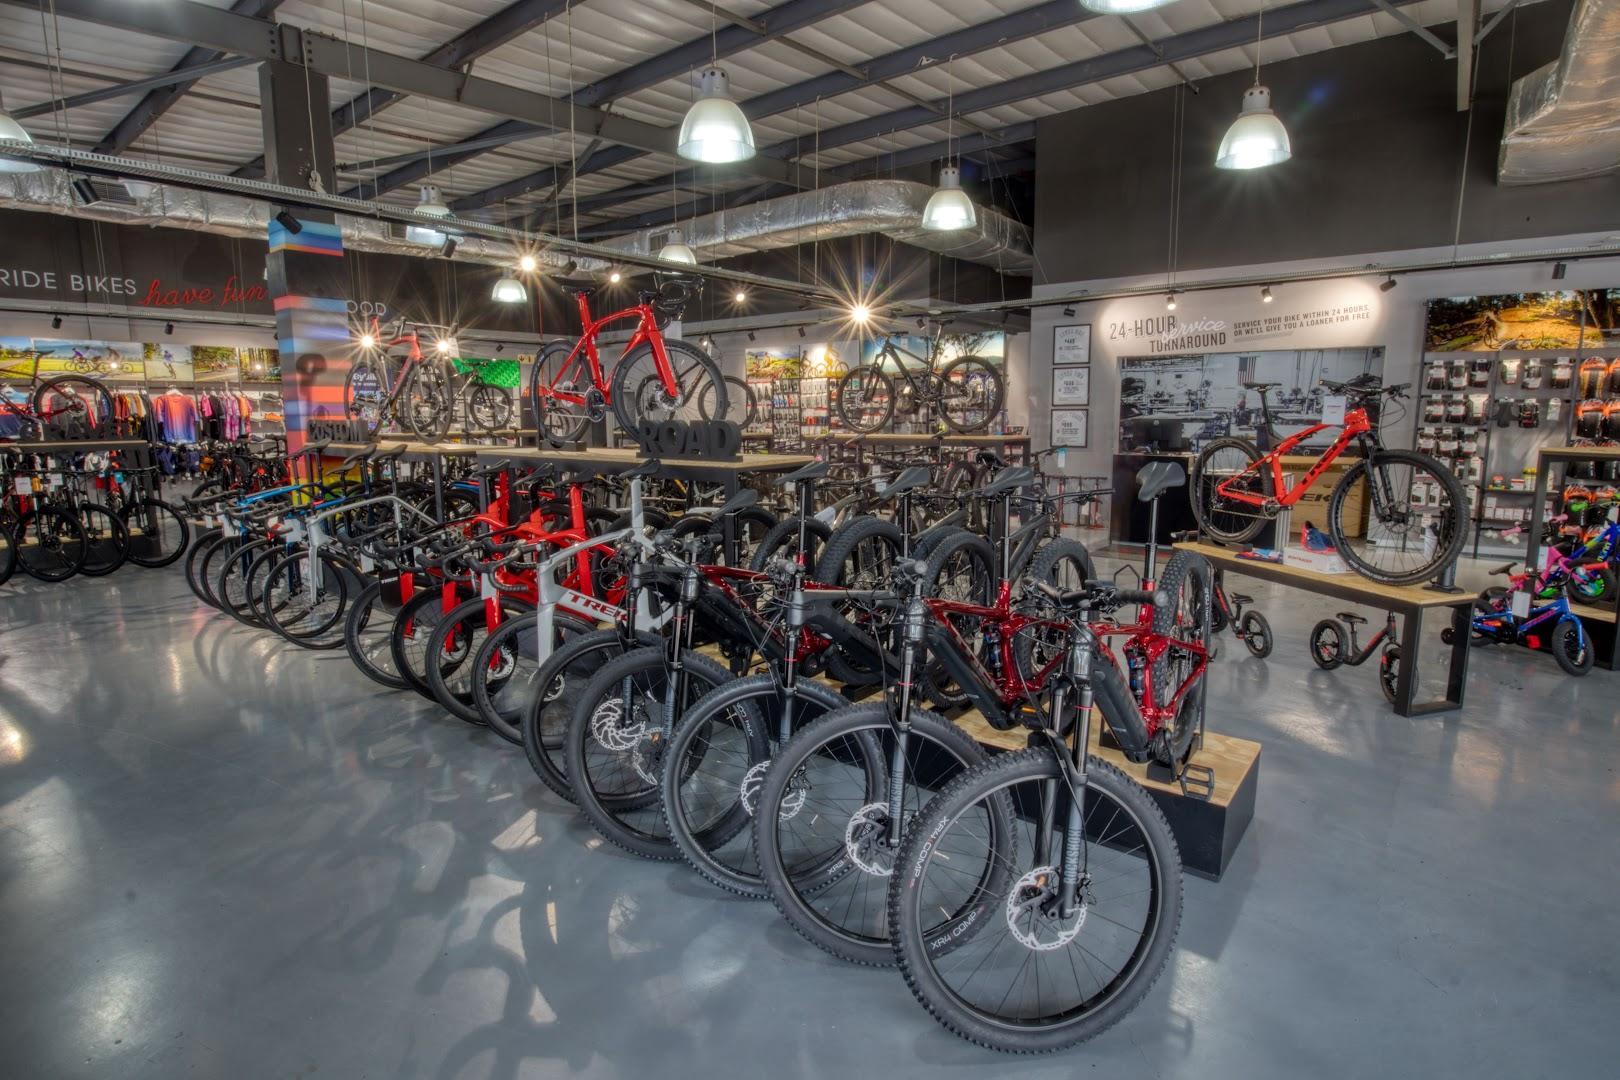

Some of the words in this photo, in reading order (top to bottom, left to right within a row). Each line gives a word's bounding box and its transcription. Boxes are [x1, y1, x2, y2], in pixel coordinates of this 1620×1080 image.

[0, 268, 57, 289] RIDE
[70, 274, 137, 295] BIKES
[137, 278, 215, 307] have
[218, 274, 268, 310] fun
[1109, 315, 1176, 339] 24-HOUR
[1233, 319, 1261, 330] SERVICE
[1263, 316, 1282, 325] YOUR
[1284, 313, 1301, 322] BIKE
[1302, 309, 1330, 320] WITHIN
[1332, 308, 1341, 316] 24
[1343, 304, 1369, 314] HOURS
[1233, 329, 1243, 337] OR
[1265, 323, 1281, 332] GIVE
[1283, 322, 1298, 330] YOU
[1299, 320, 1305, 328] A
[1306, 317, 1334, 327] LOANER
[1336, 314, 1350, 323] FOR
[1352, 311, 1370, 320] FREE
[1149, 331, 1227, 353] TURNAROUND
[639, 420, 742, 458] ROAD
[568, 591, 628, 622] TREK
[930, 815, 951, 839] XR4
[914, 841, 933, 878] COMP
[1063, 828, 1081, 885] ROCKSHOX
[930, 933, 953, 951] XR4
[952, 911, 977, 938] COMP
